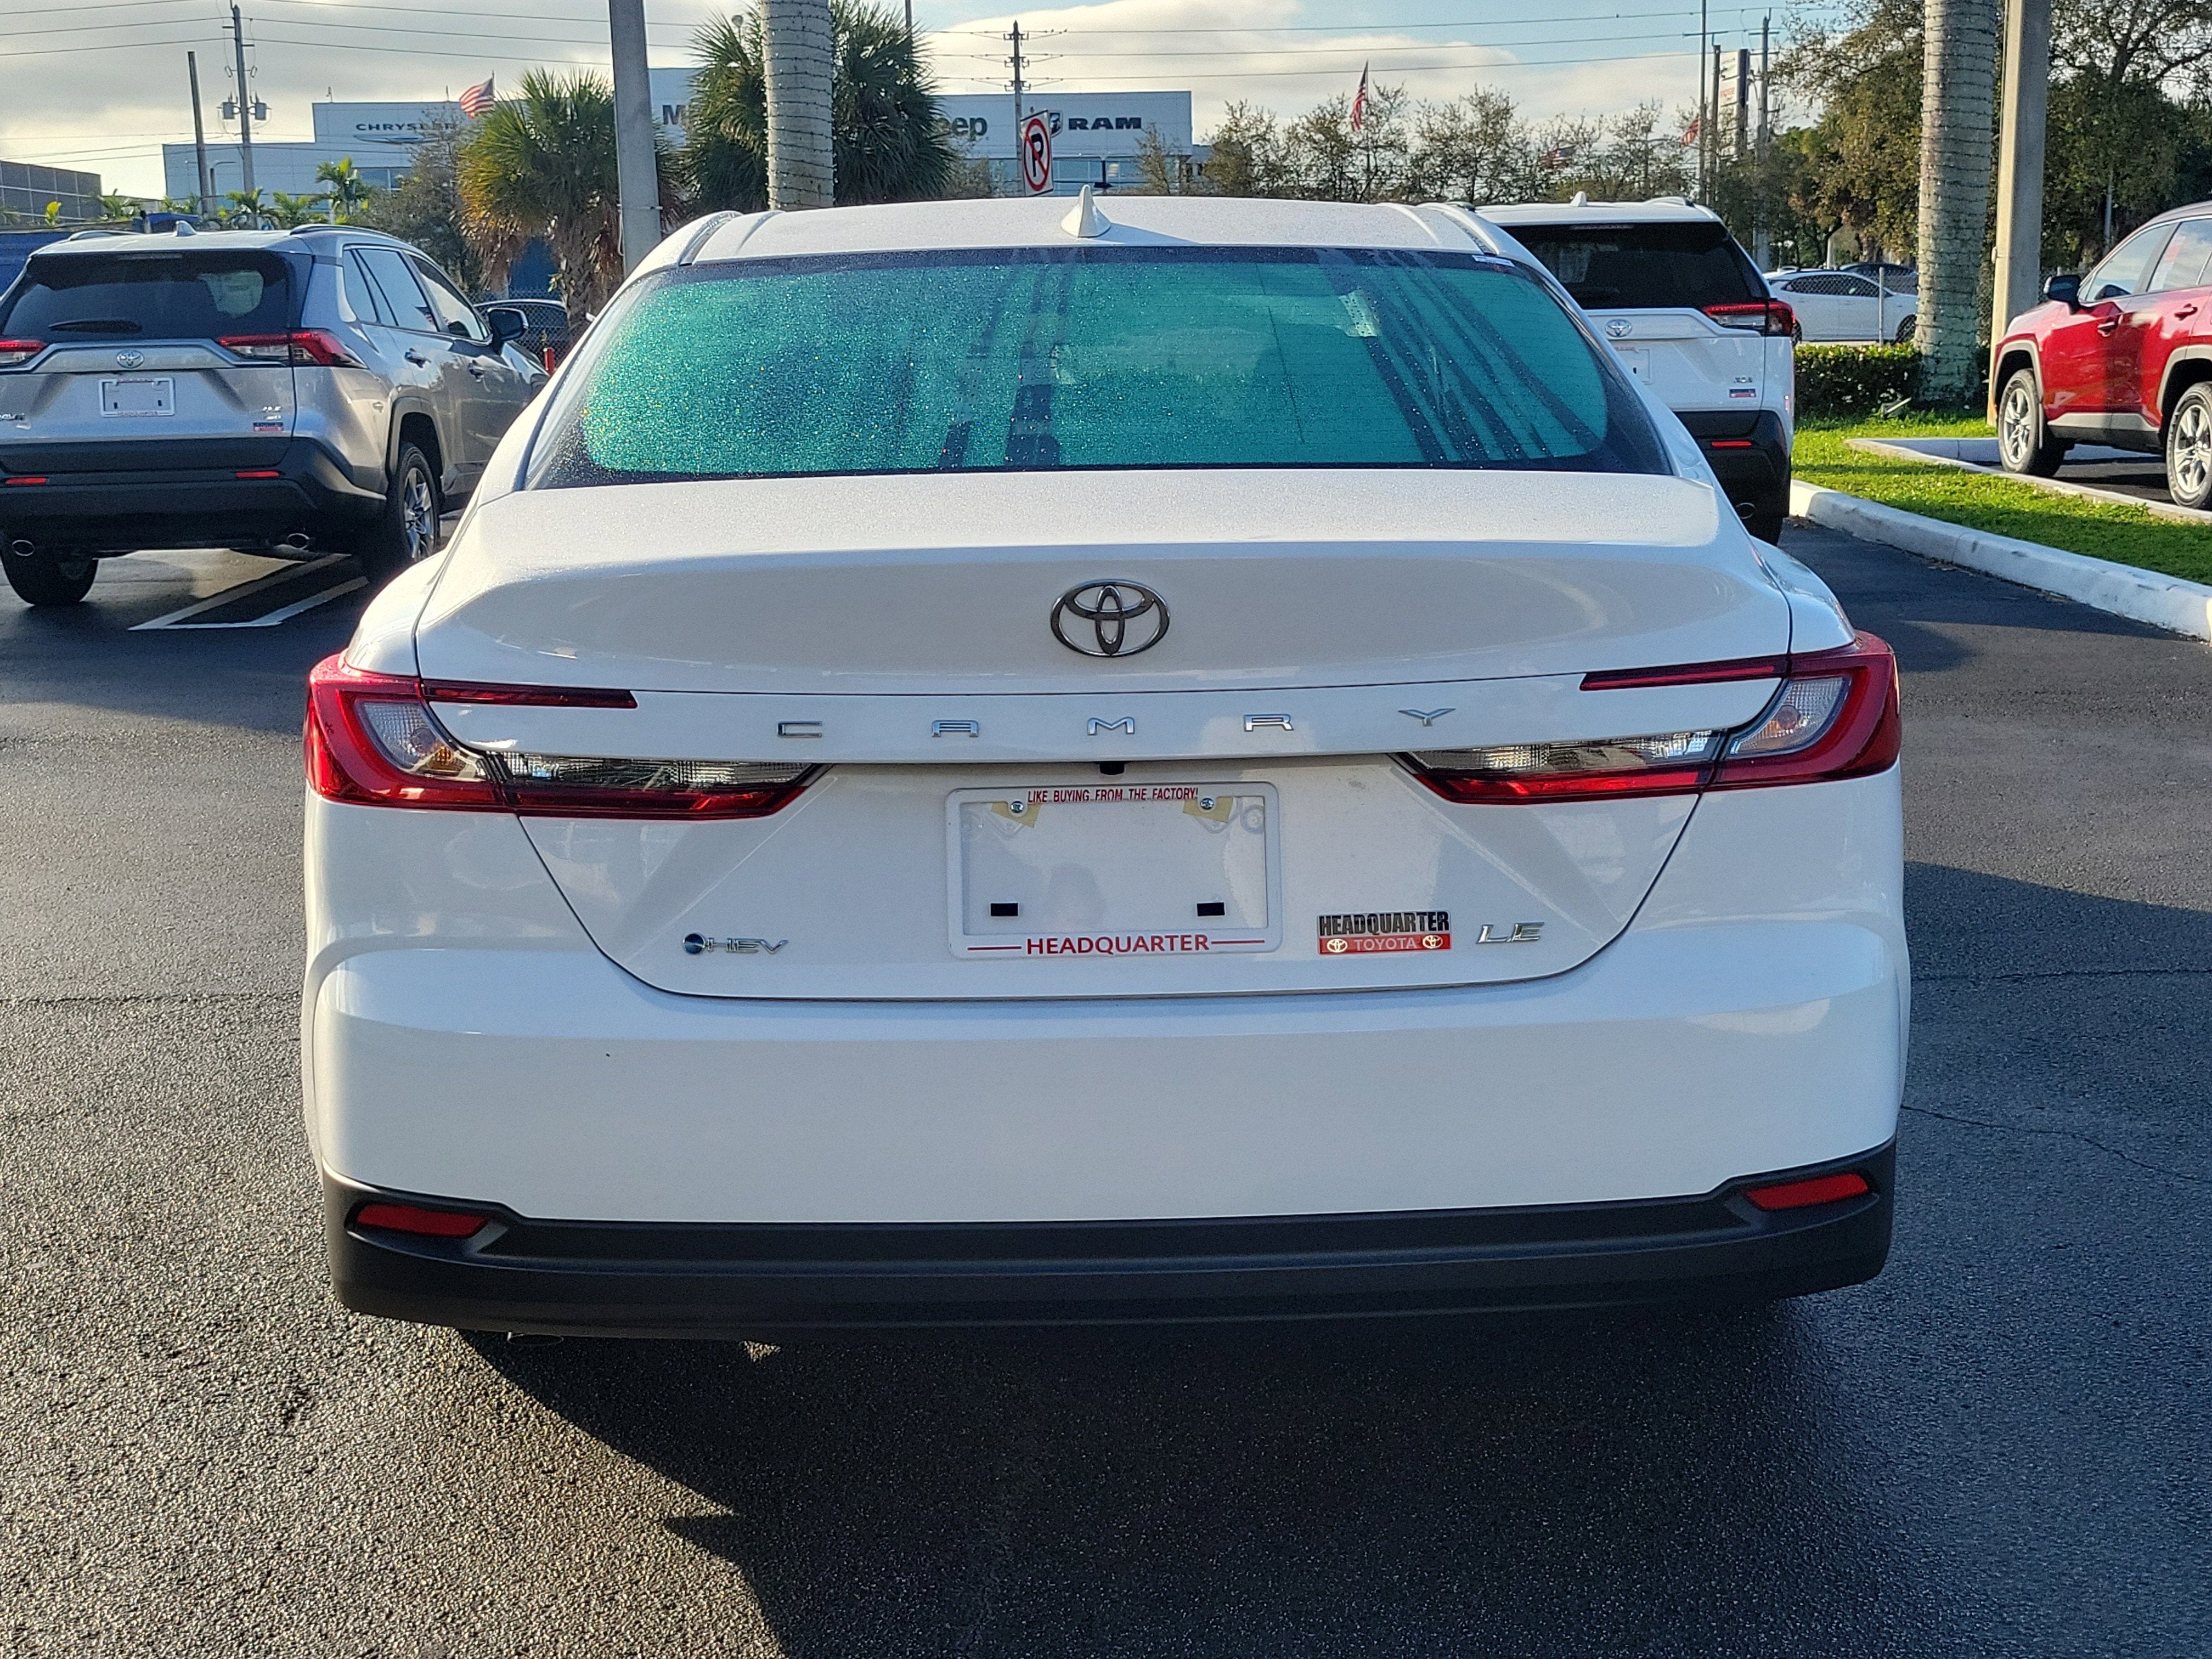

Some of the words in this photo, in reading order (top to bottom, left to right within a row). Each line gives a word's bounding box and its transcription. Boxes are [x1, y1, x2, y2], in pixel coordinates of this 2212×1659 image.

[1069, 117, 1141, 130] RAM
[1027, 791, 1048, 803] LIKE
[1053, 789, 1090, 802] BUYING
[1095, 789, 1123, 801] FROM
[1128, 788, 1147, 800] THE
[1152, 787, 1198, 800] FACTORY!
[1318, 911, 1449, 936] HEADQUARTER
[1475, 921, 1545, 945] LE
[707, 937, 789, 954] HEV
[1026, 934, 1210, 955] HEADQUARTER
[1353, 937, 1418, 951] TOYOTA
